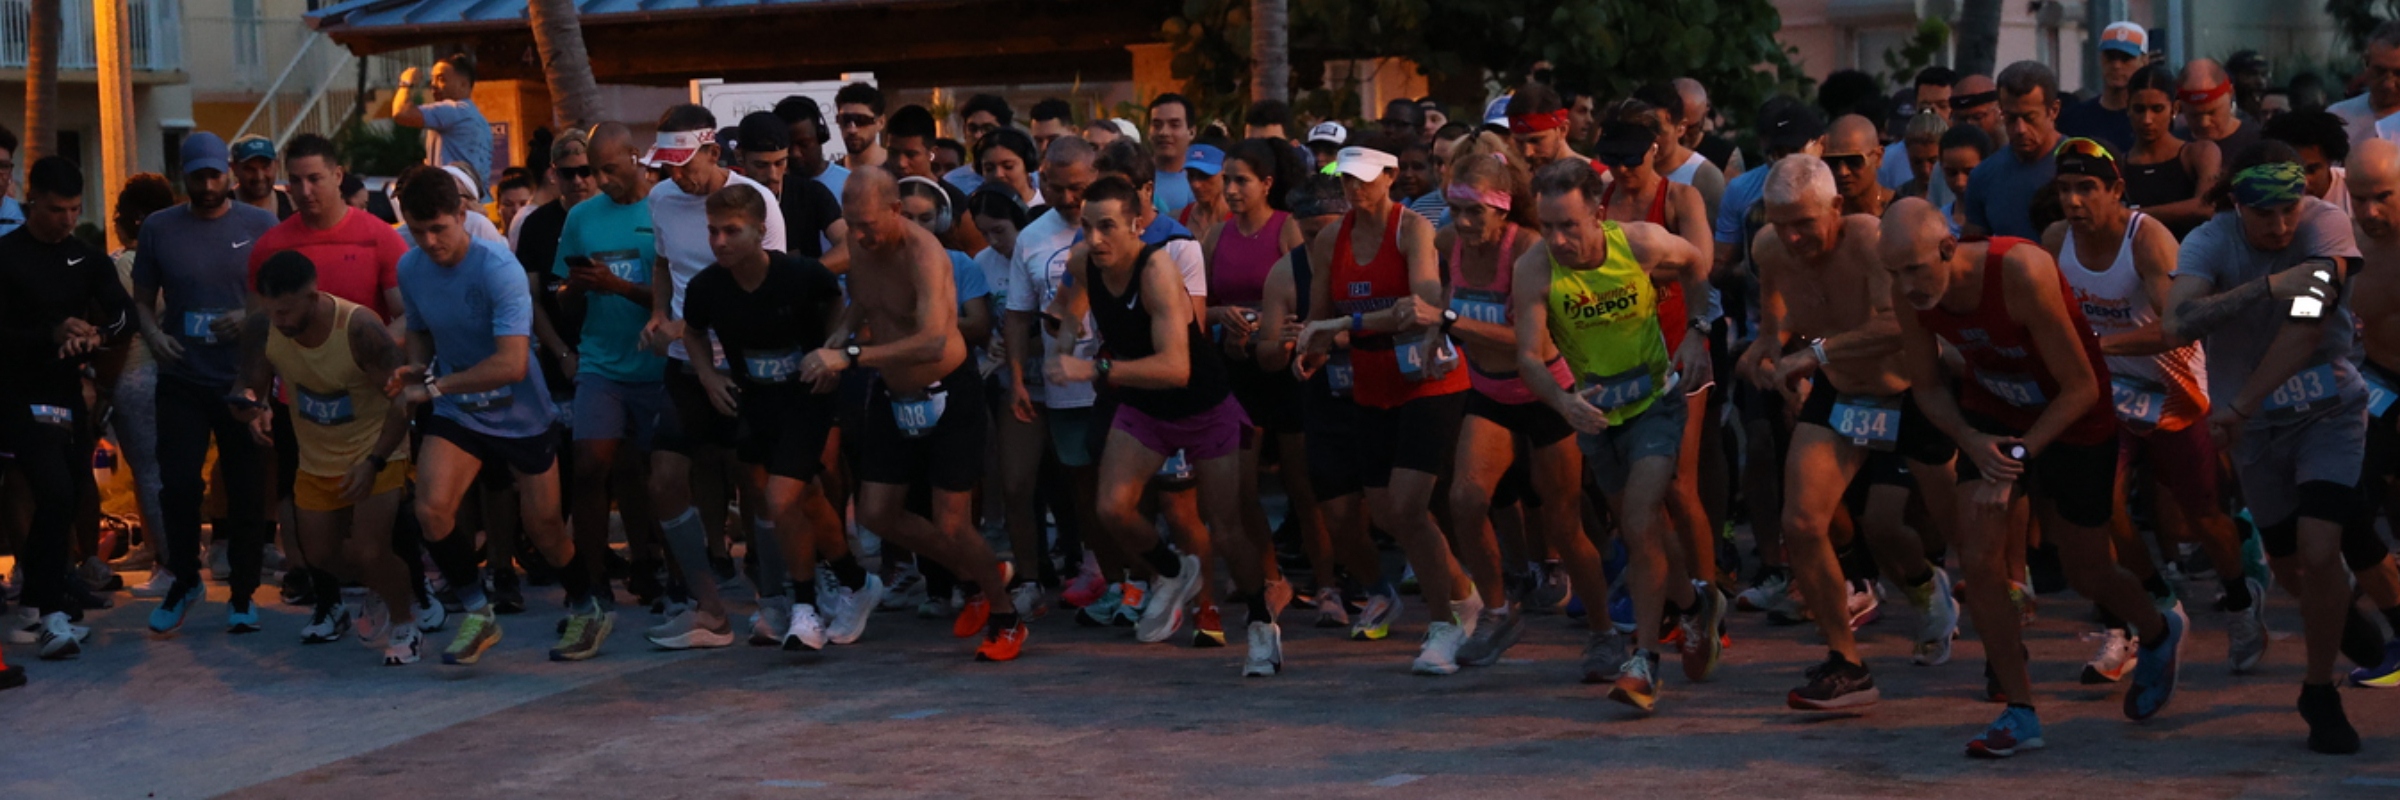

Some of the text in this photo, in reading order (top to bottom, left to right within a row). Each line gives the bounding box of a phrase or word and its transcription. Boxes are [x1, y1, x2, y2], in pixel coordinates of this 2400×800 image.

[1460, 303, 1498, 323] 410
[1583, 293, 1639, 318] DEPOT
[2083, 303, 2131, 319] DEPOT
[754, 356, 797, 377] 725
[1596, 381, 1641, 405] 714
[304, 396, 341, 418] 737
[898, 404, 927, 426] 408
[1839, 408, 1887, 437] 834
